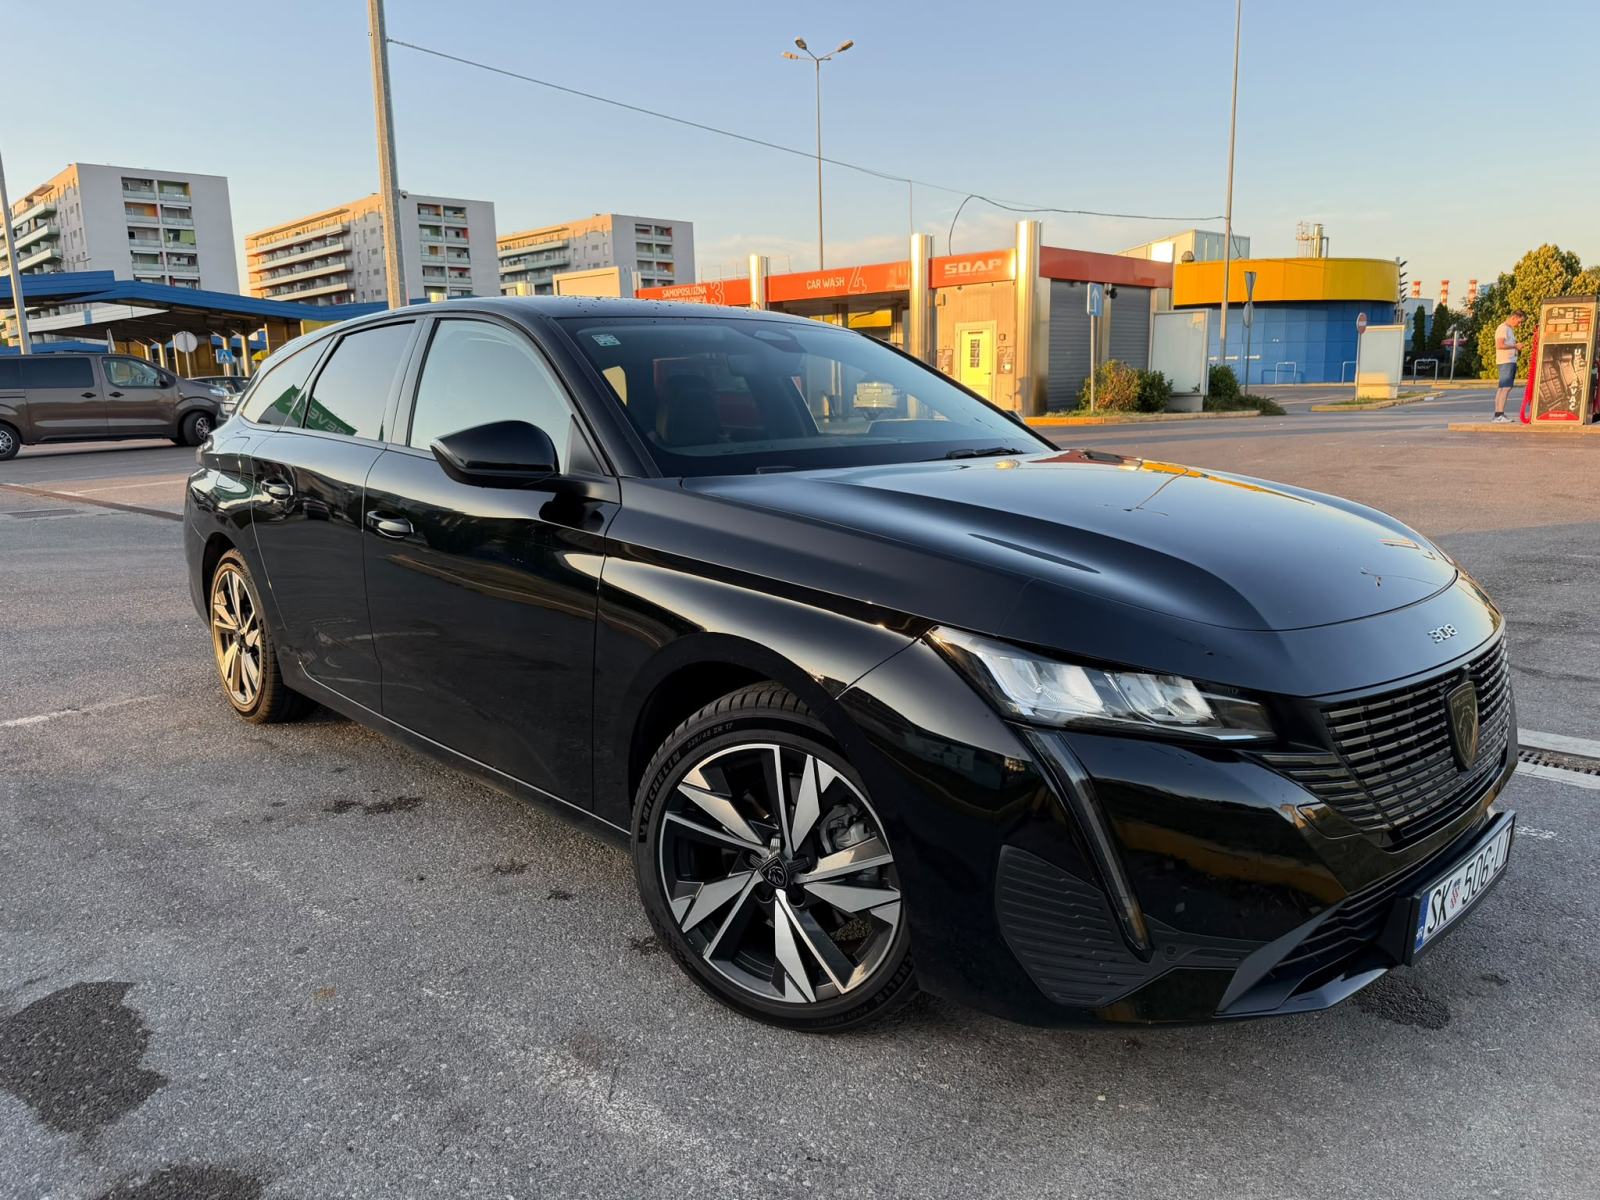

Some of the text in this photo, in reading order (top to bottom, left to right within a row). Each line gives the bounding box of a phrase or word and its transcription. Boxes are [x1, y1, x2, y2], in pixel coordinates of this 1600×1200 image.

[944, 258, 1002, 275] SOAP
[711, 281, 725, 305] 3
[806, 277, 845, 290] CAR WASH
[1427, 623, 1458, 644] 308
[642, 751, 681, 819] MICHELIN
[1427, 879, 1453, 934] SK
